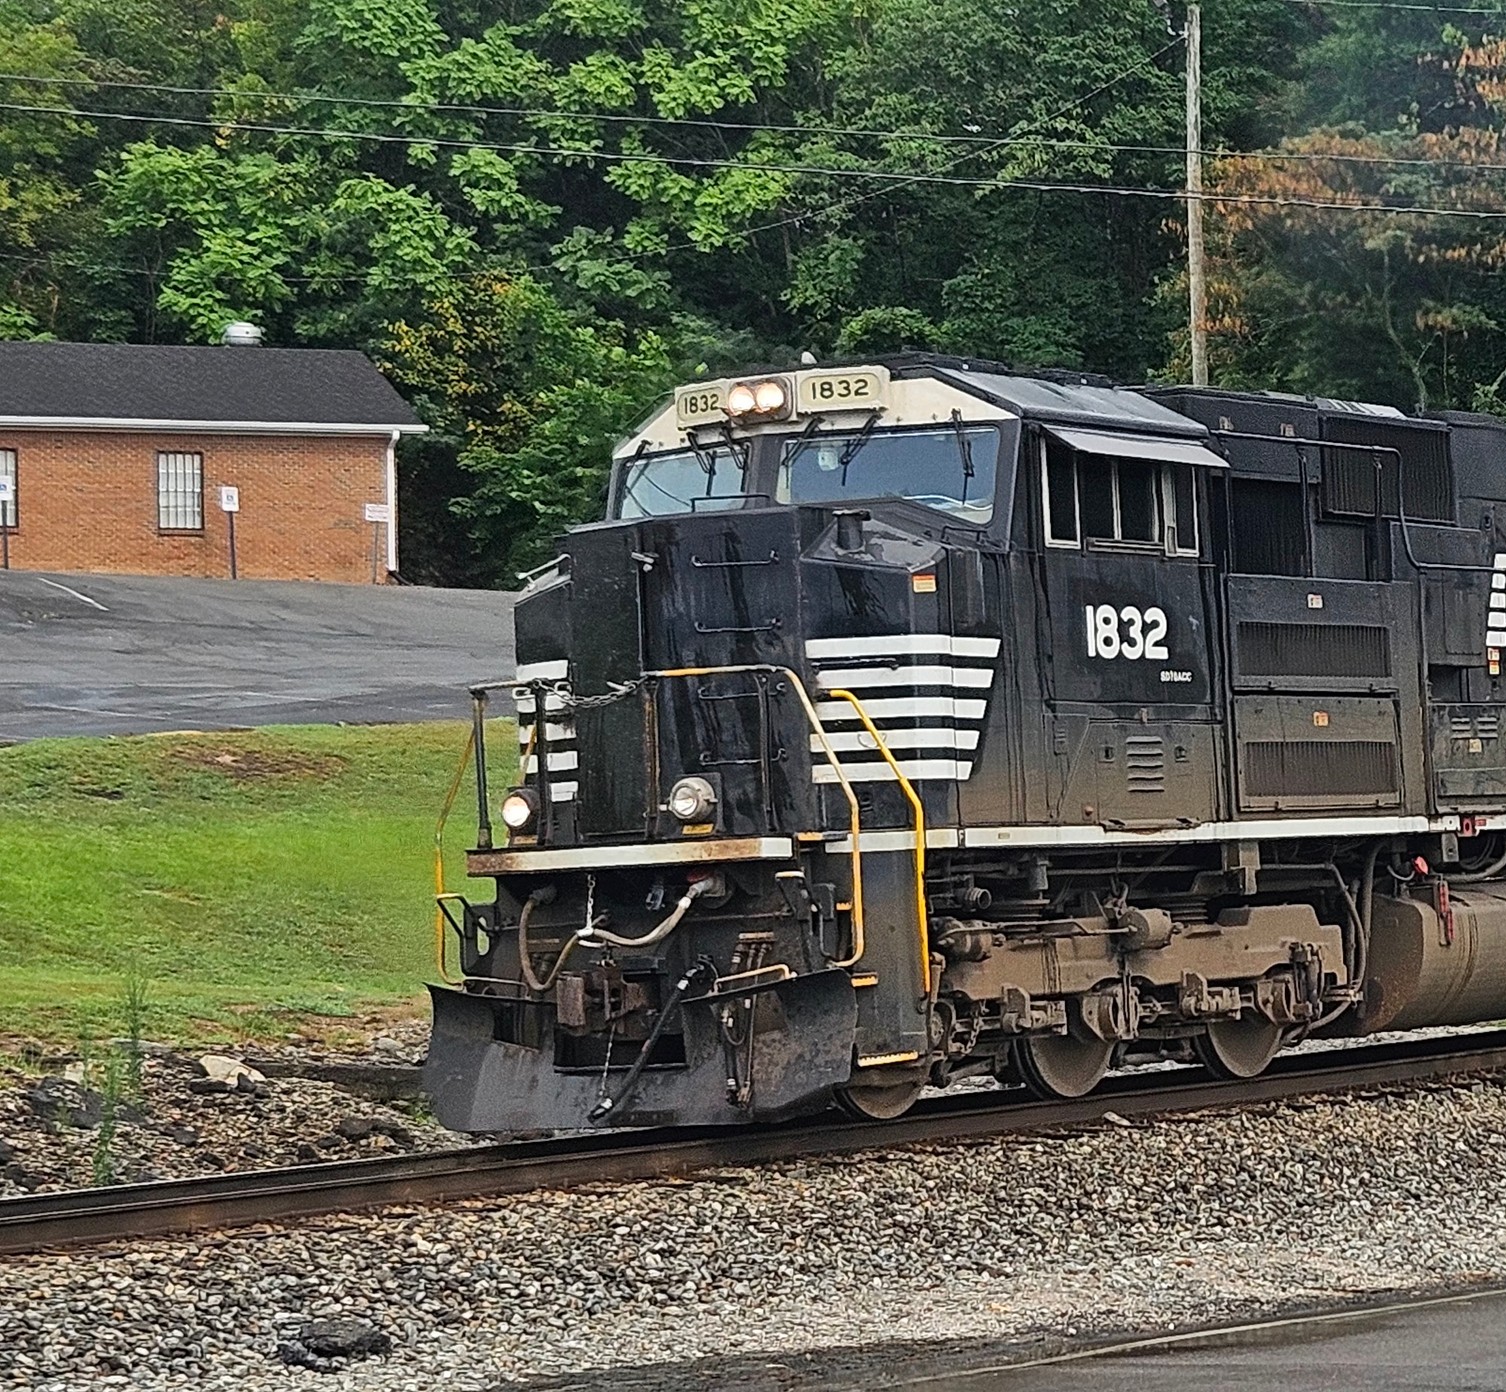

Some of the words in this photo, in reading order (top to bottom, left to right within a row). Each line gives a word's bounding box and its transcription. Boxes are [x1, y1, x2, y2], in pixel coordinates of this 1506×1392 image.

[811, 378, 870, 400] 1832
[684, 393, 719, 415] 1832
[1085, 604, 1169, 660] 1832
